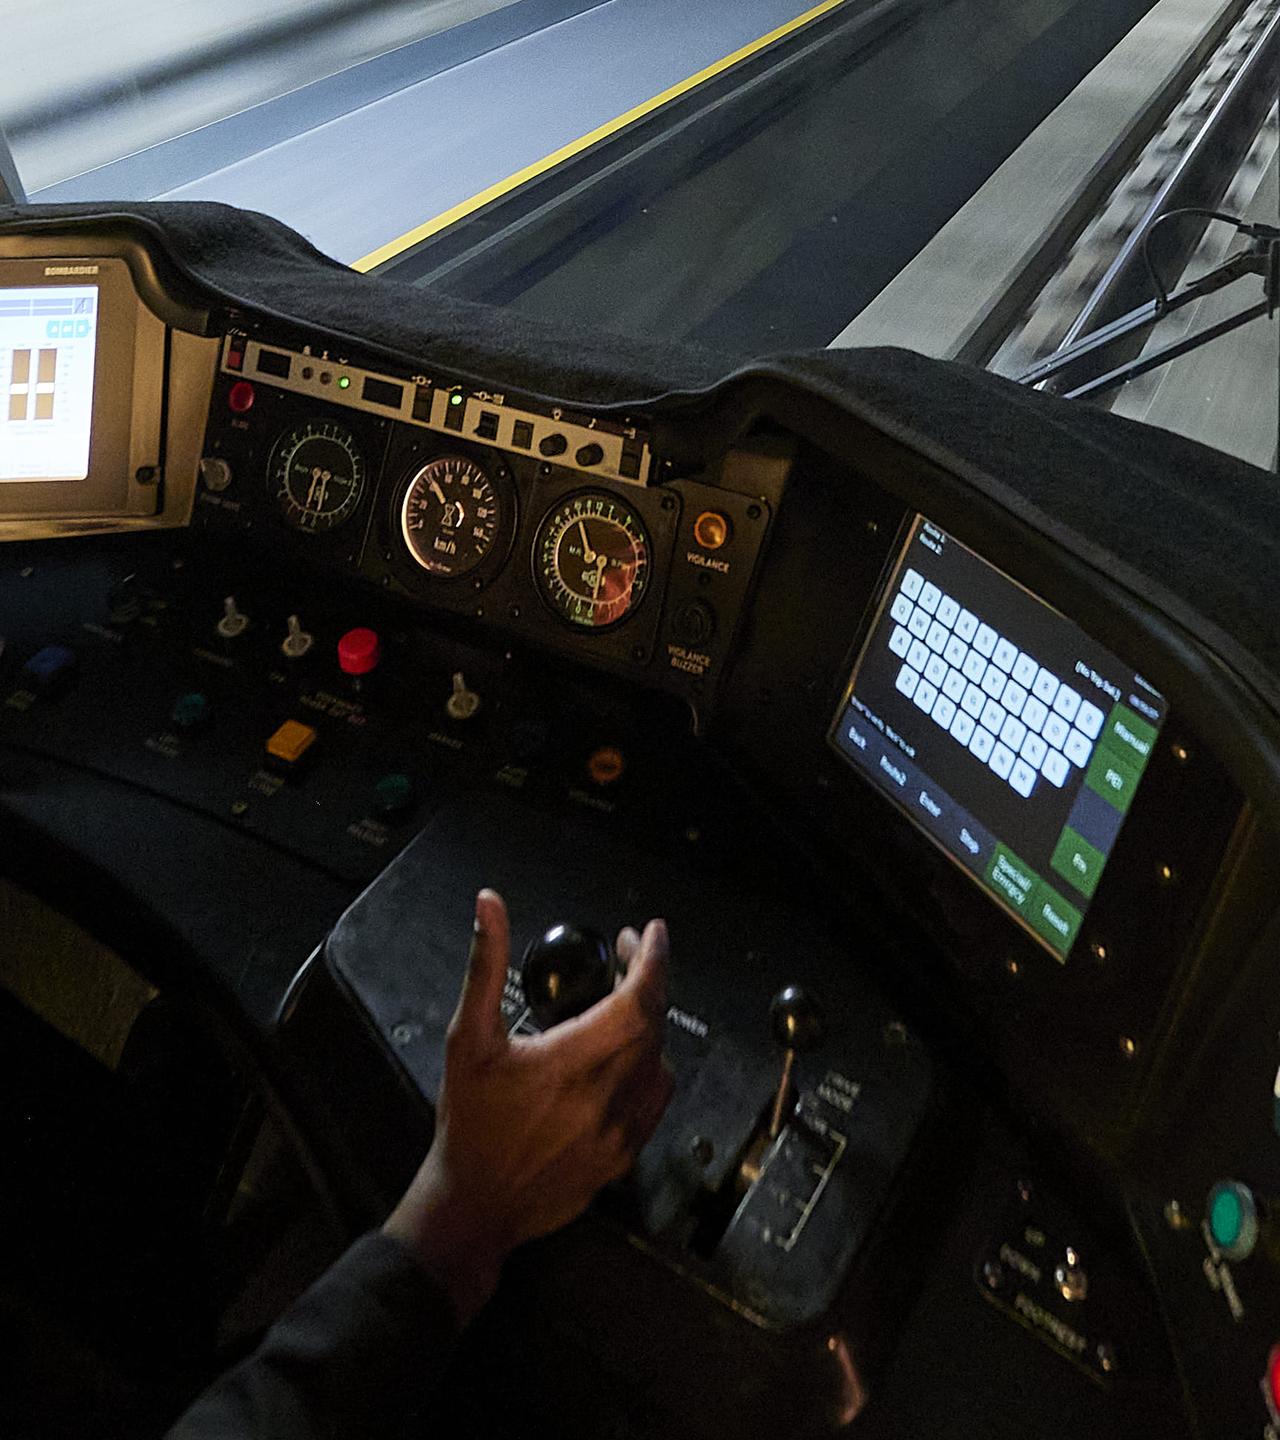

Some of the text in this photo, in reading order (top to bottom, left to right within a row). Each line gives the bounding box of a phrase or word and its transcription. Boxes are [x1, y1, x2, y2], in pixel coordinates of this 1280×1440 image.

[44, 265, 99, 276] BOMBARDIER
[433, 536, 456, 554] km/h
[687, 551, 731, 575] VIGILANCE
[667, 644, 712, 668] VIGILANCE
[671, 656, 705, 675] BUZZER
[1113, 721, 1150, 756] Manual
[848, 726, 867, 750] Back
[919, 791, 941, 818] Enter
